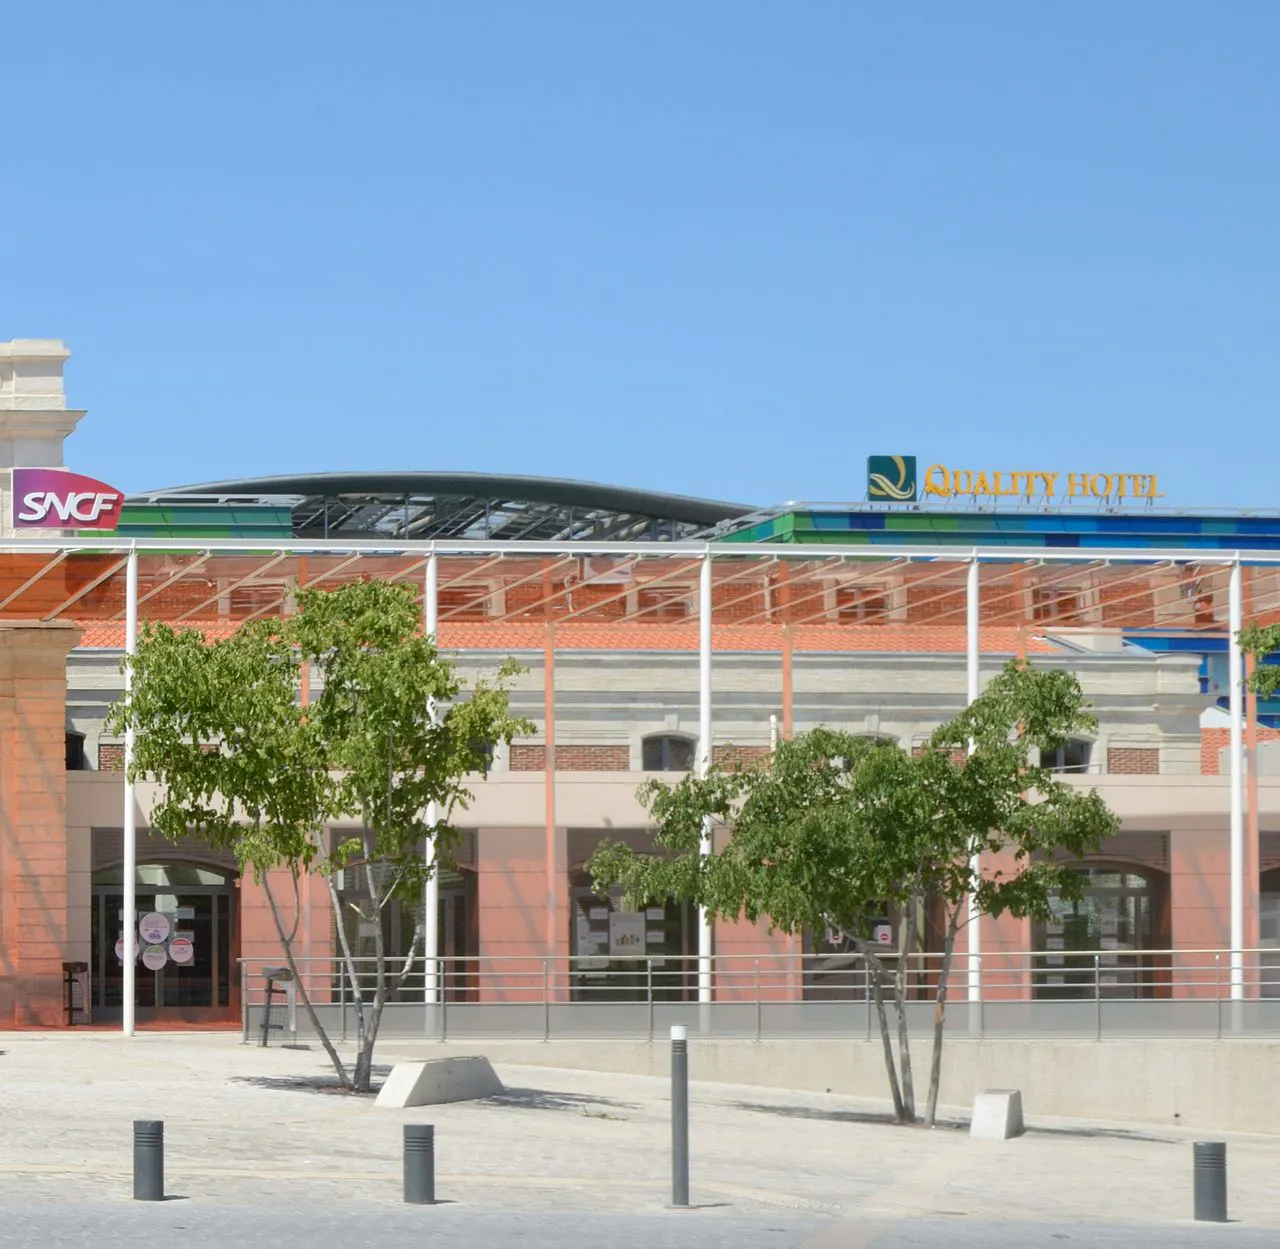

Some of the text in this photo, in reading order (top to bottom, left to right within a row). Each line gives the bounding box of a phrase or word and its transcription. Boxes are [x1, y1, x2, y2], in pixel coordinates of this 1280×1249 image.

[924, 464, 1166, 498] QUALITY HOTEL
[18, 492, 118, 522] SNCF
